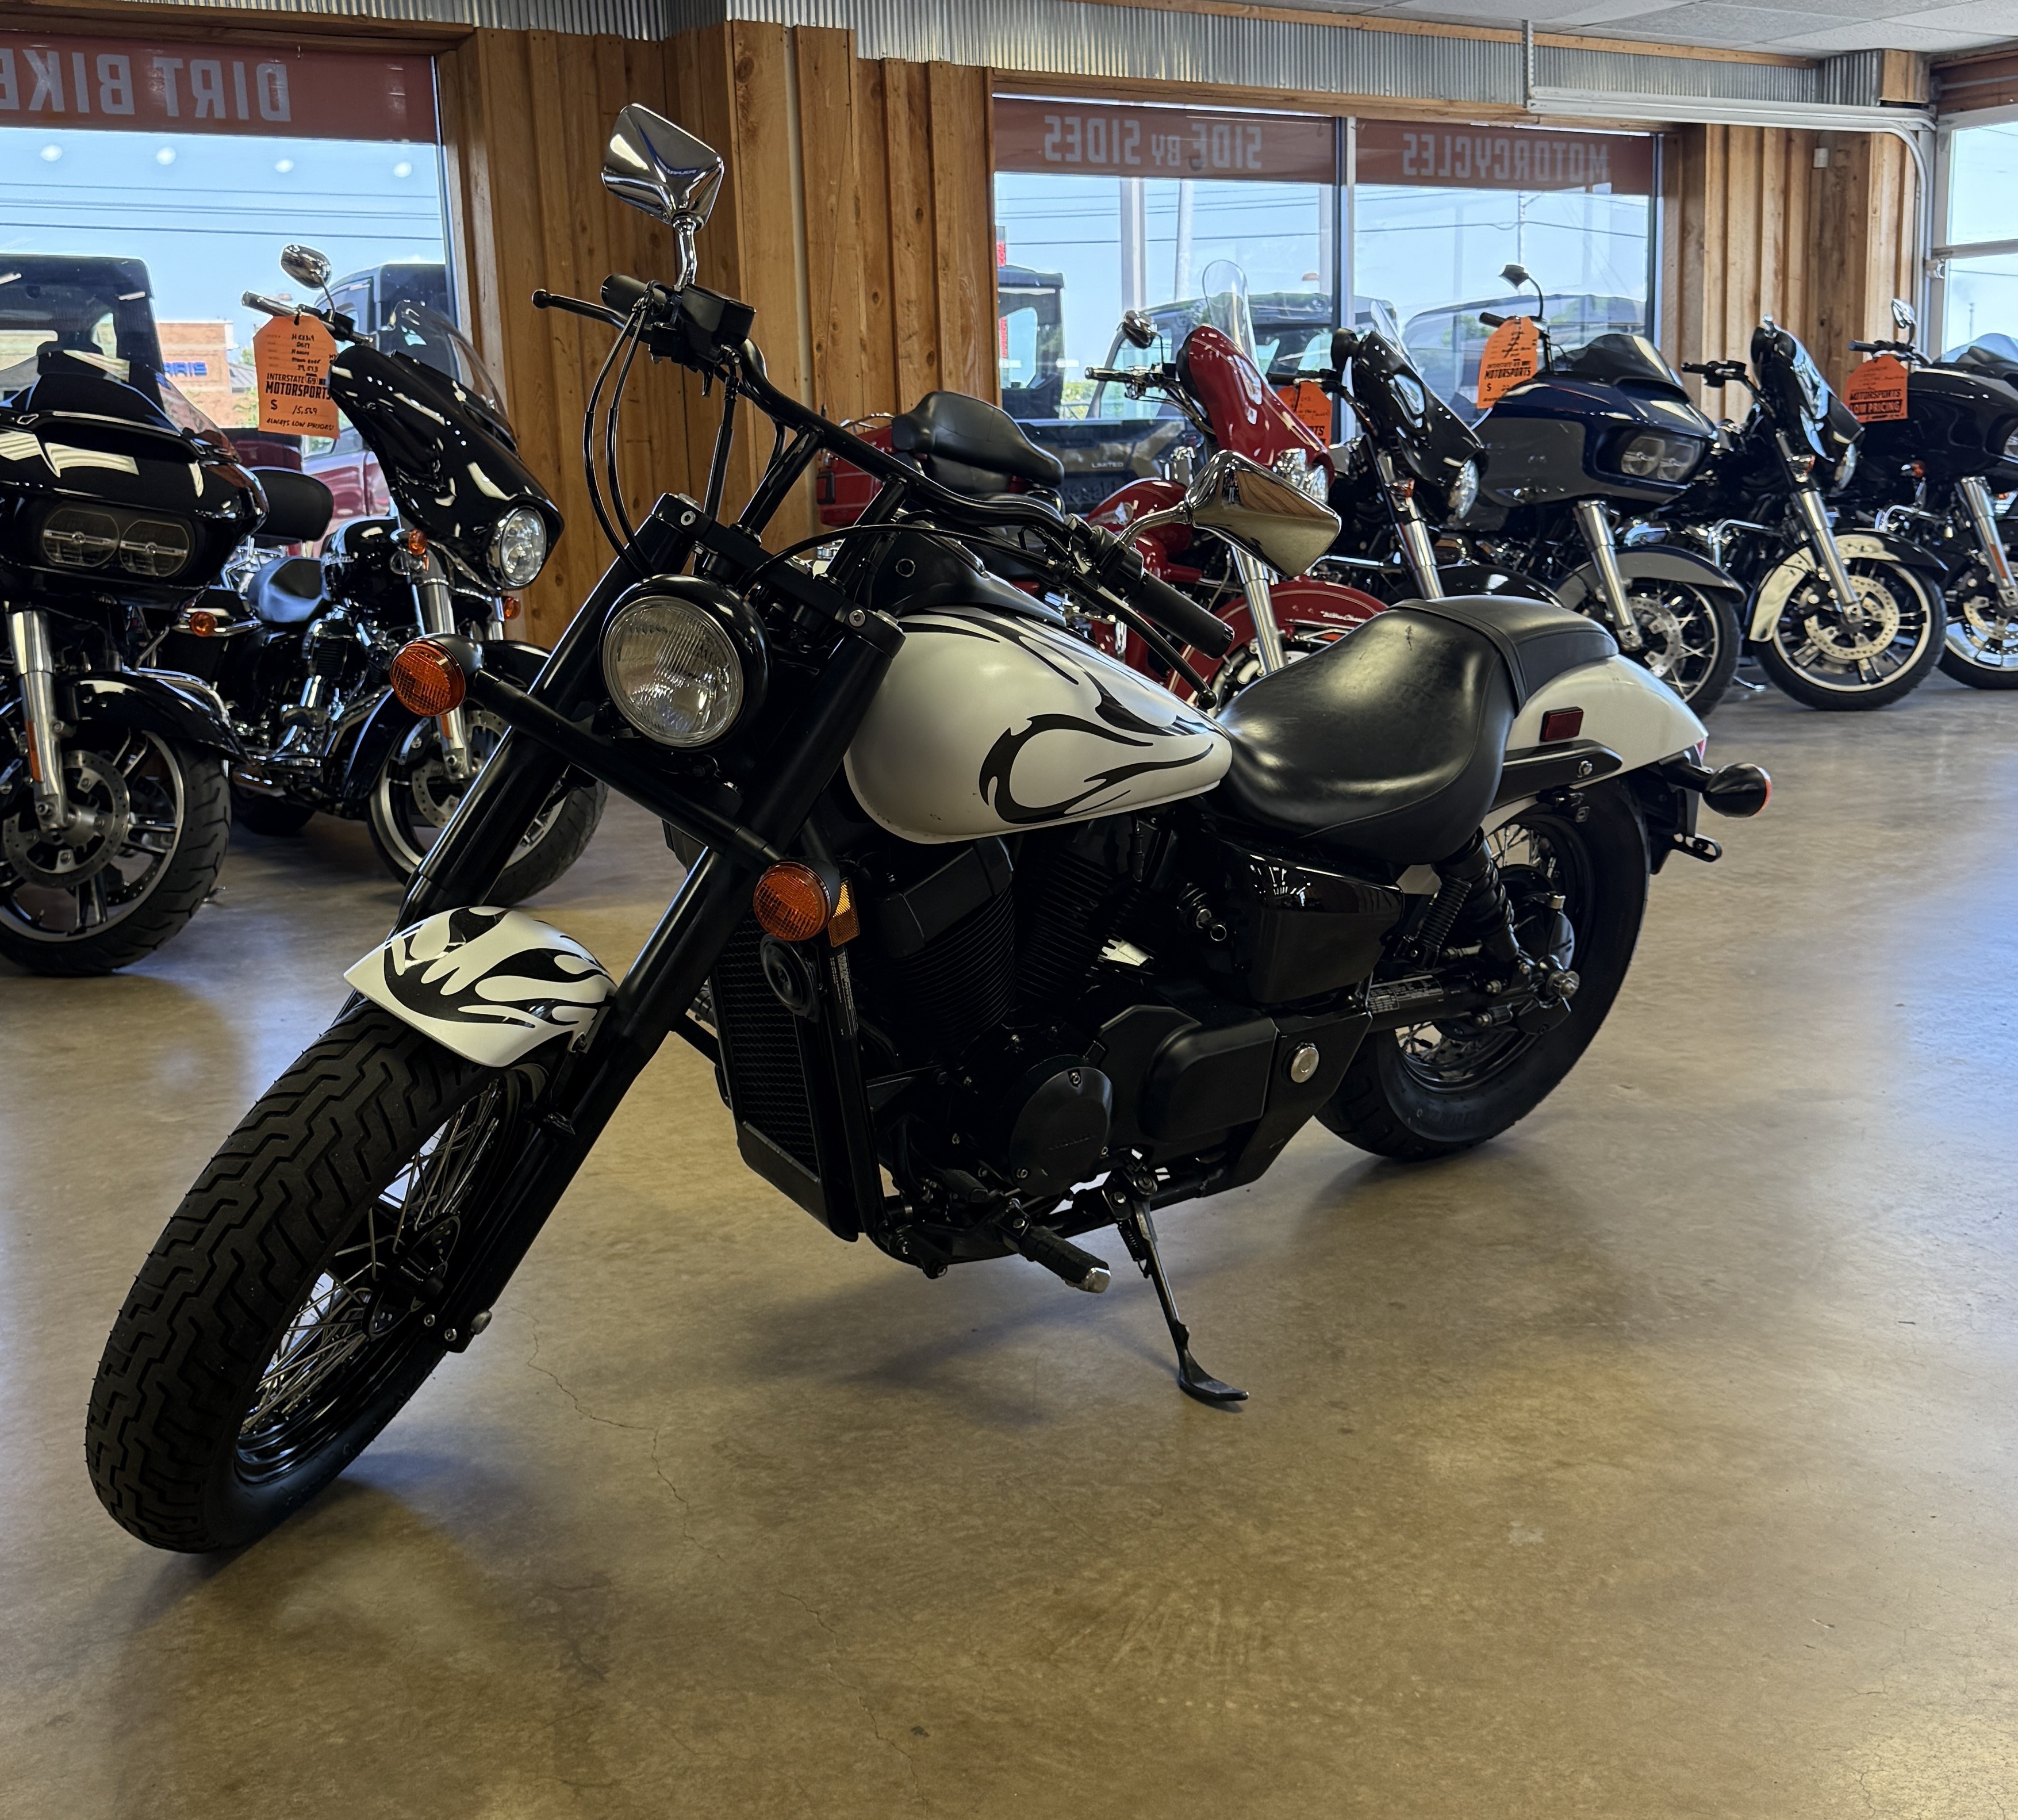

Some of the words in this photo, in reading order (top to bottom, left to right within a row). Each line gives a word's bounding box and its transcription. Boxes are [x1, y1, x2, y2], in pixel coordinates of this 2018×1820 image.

[267, 373, 304, 384] INTERSTATE
[271, 399, 278, 410] $
[266, 418, 290, 427] ALWAYS
